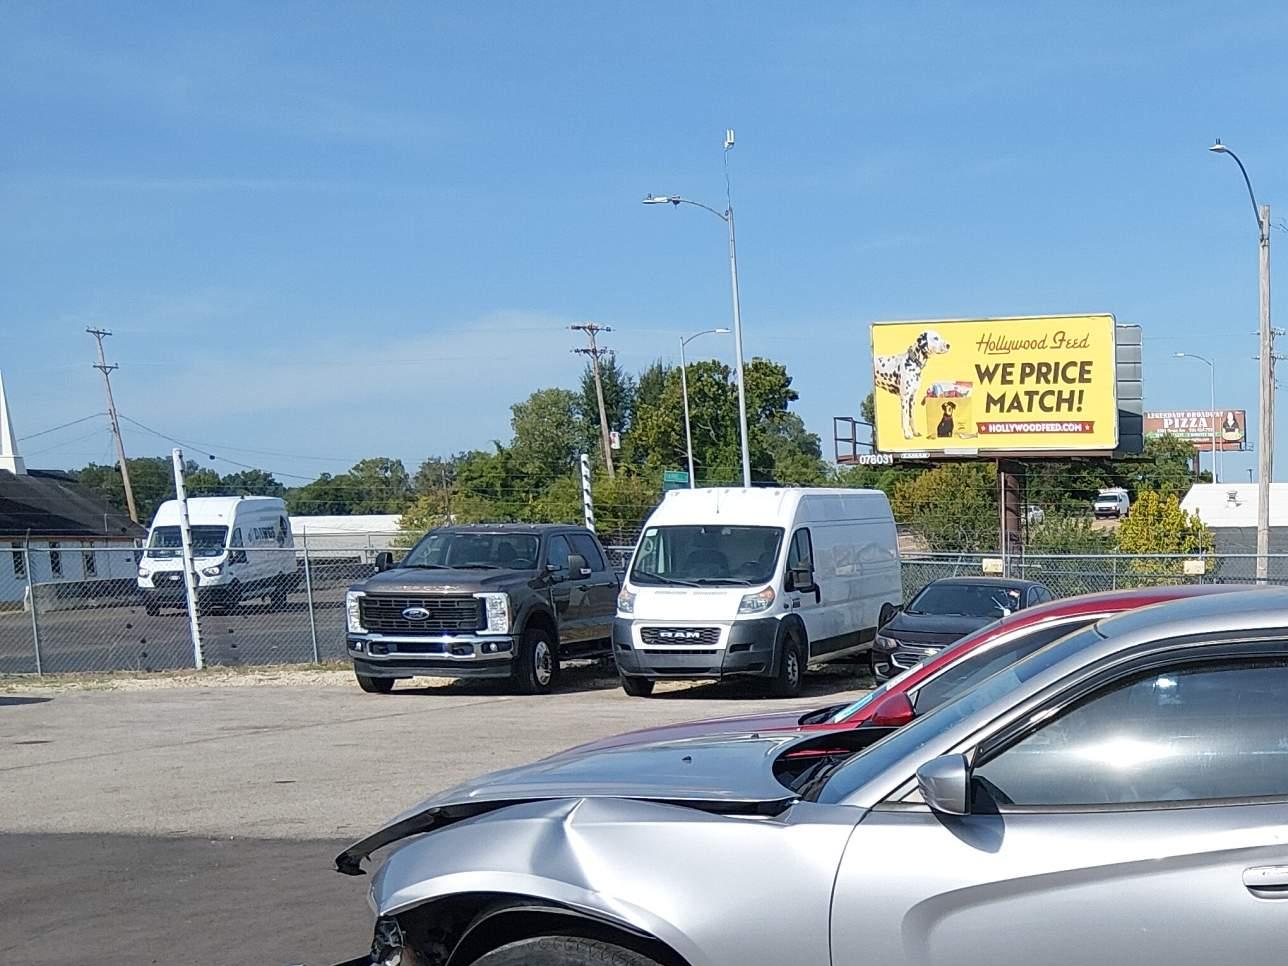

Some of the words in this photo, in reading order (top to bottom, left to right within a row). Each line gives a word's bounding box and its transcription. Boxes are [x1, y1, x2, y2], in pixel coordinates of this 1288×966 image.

[976, 332, 1048, 355] Hollywood
[1049, 330, 1090, 349] Feed
[975, 363, 1014, 385] WE
[1020, 360, 1093, 385] PRICE
[985, 389, 1083, 414] MATCH!
[988, 423, 1082, 433] HOLLYWOODFEED.COM
[1163, 417, 1208, 429] PIZZA
